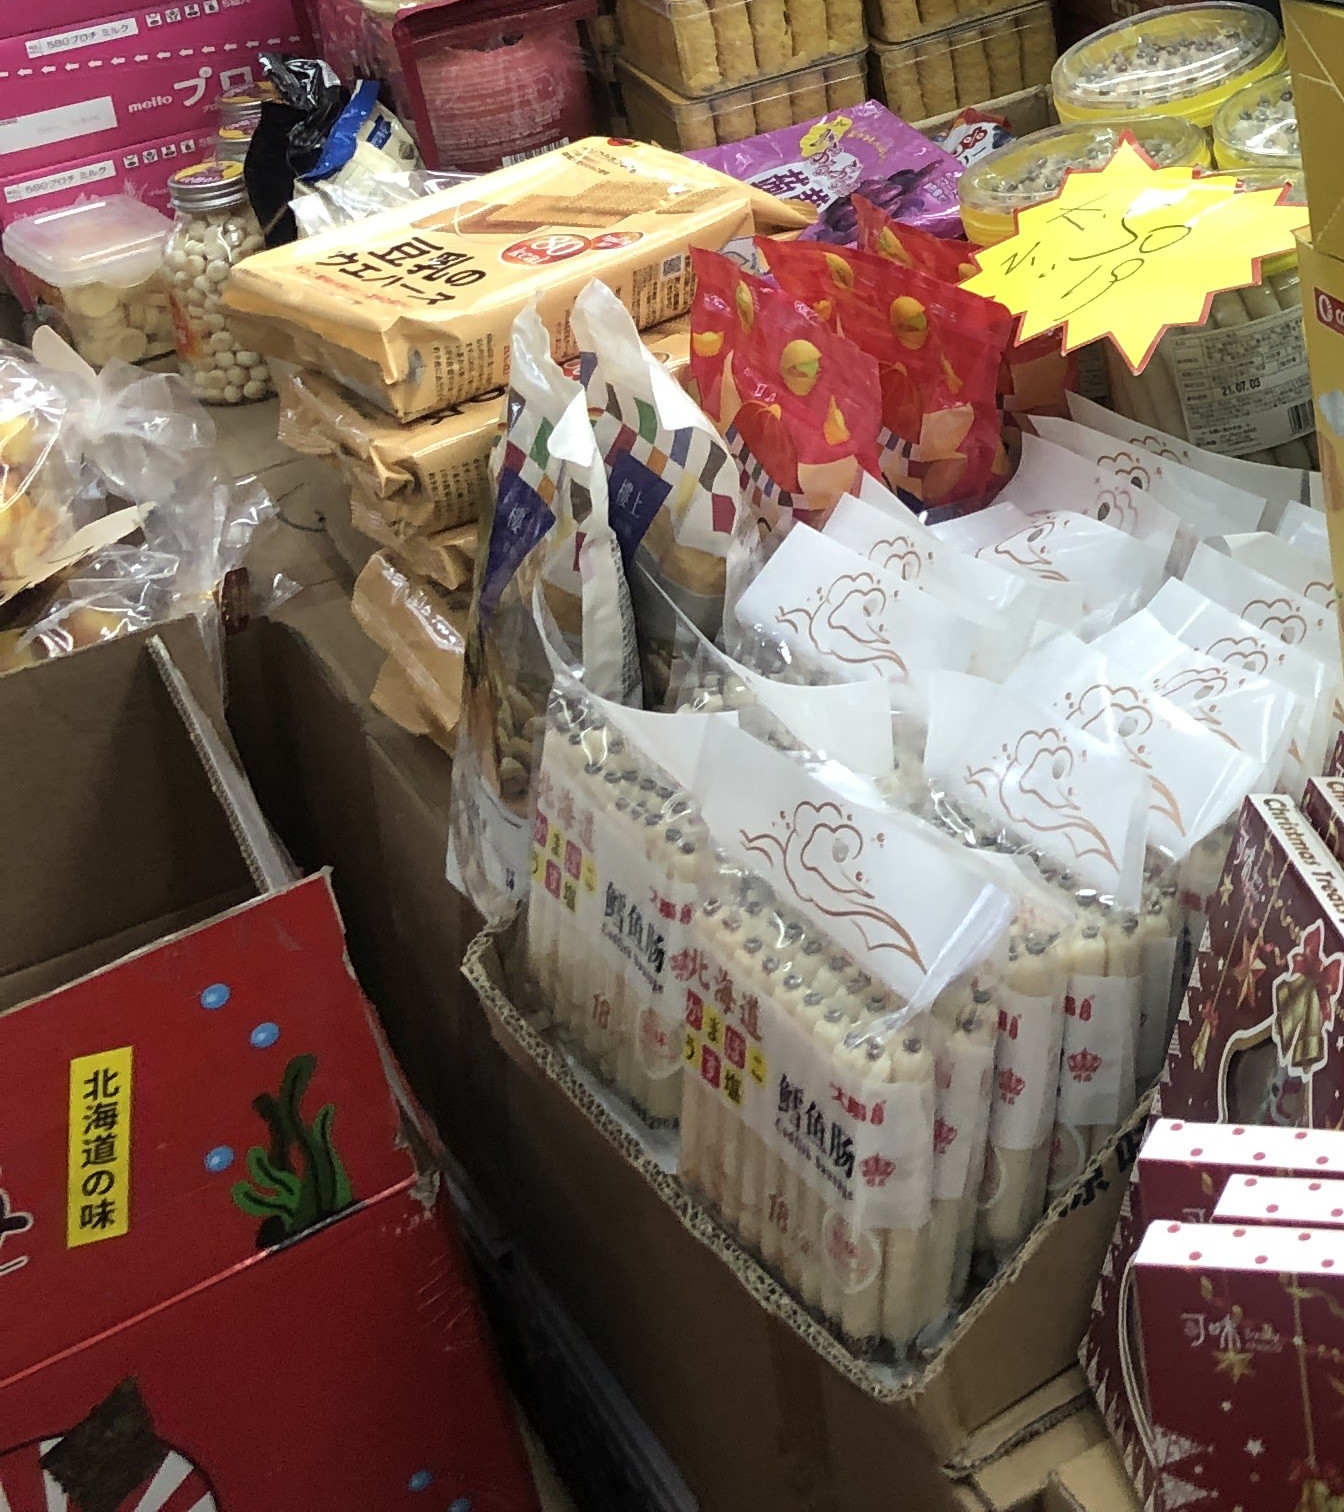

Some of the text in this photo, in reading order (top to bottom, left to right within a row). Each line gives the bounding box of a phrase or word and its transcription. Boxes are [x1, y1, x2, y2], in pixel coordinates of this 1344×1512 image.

[128, 65, 255, 114] meito プロ
[367, 236, 488, 288] 豆乳の
[529, 234, 582, 257] 80
[315, 250, 457, 307] ウエハース
[1221, 377, 1261, 394] 21.07.03
[1262, 797, 1317, 878] Christmas
[80, 1067, 120, 1231] 北海道の味
